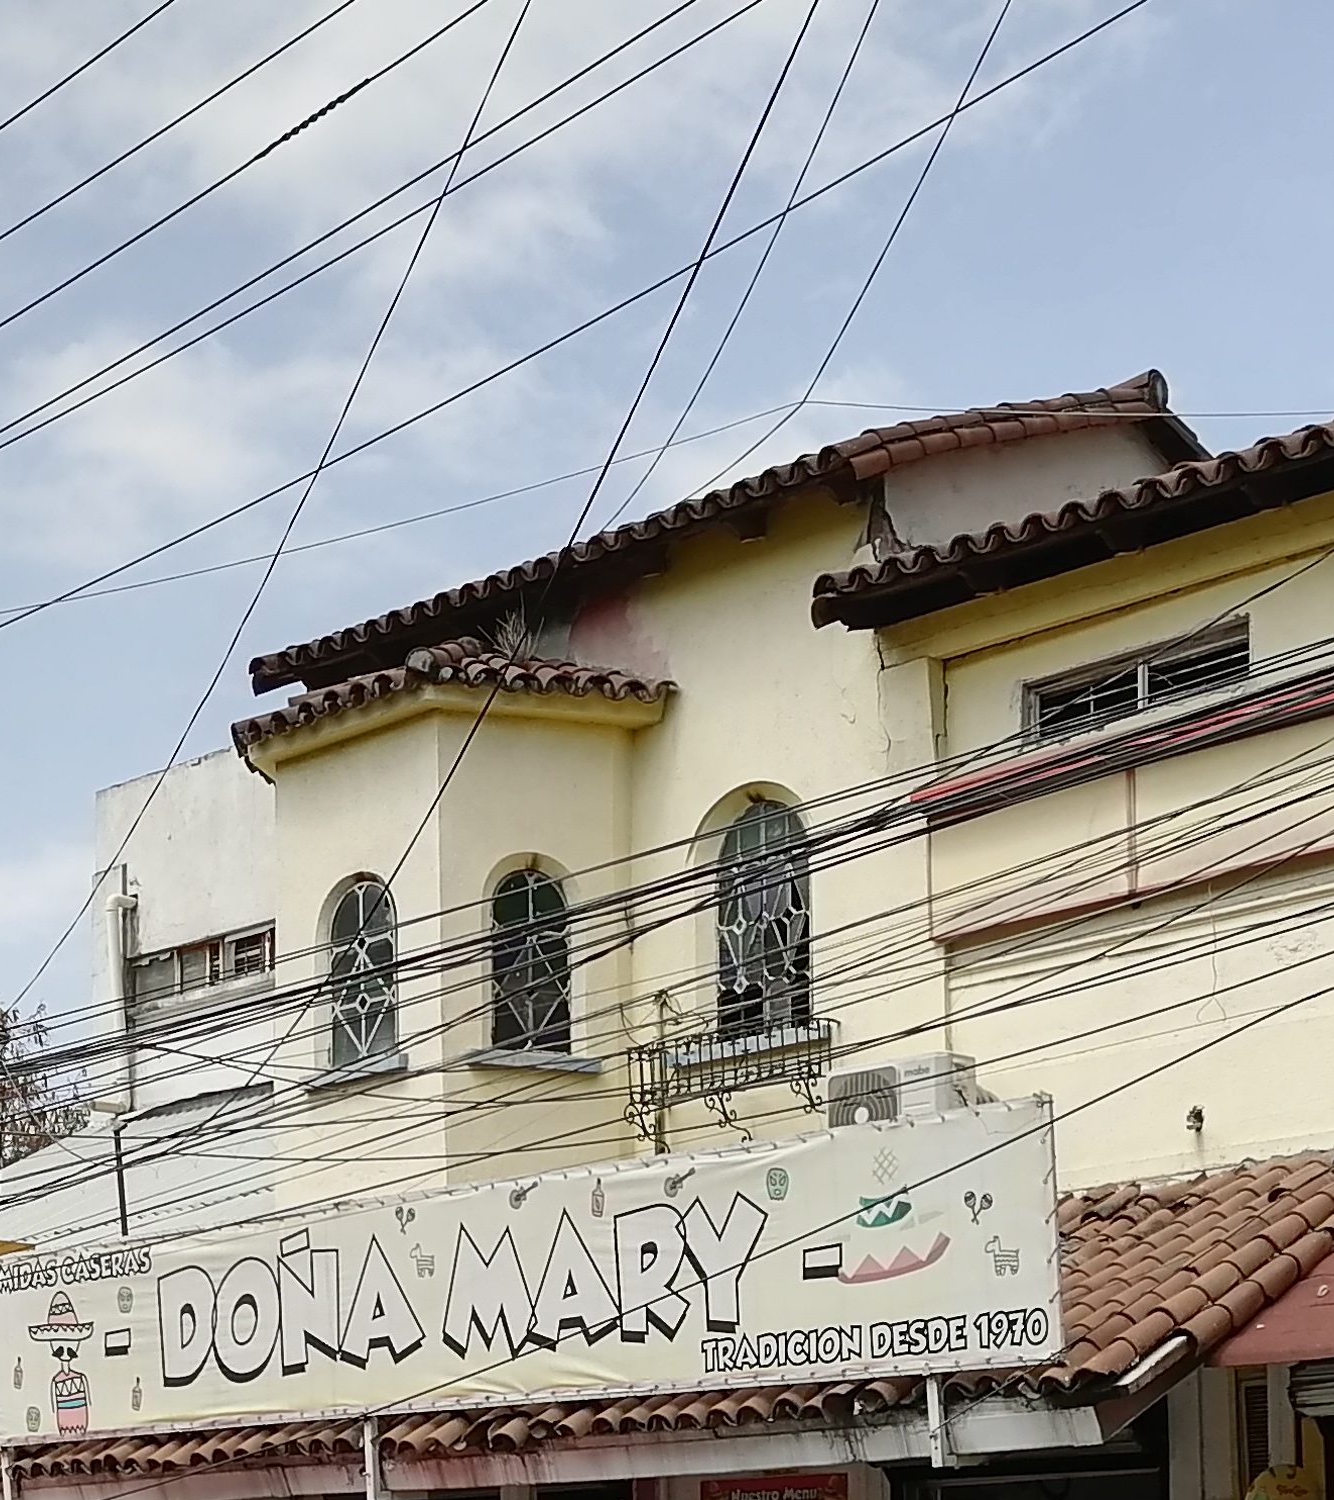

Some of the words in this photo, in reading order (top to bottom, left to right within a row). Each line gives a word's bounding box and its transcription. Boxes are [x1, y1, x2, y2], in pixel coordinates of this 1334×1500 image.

[60, 1247, 153, 1285] CASERAS
[158, 1228, 426, 1388] DOÑA
[442, 1193, 768, 1360] MARY
[702, 1325, 862, 1373] TRADICION
[870, 1314, 968, 1359] DESDE
[973, 1307, 1049, 1350] 1970
